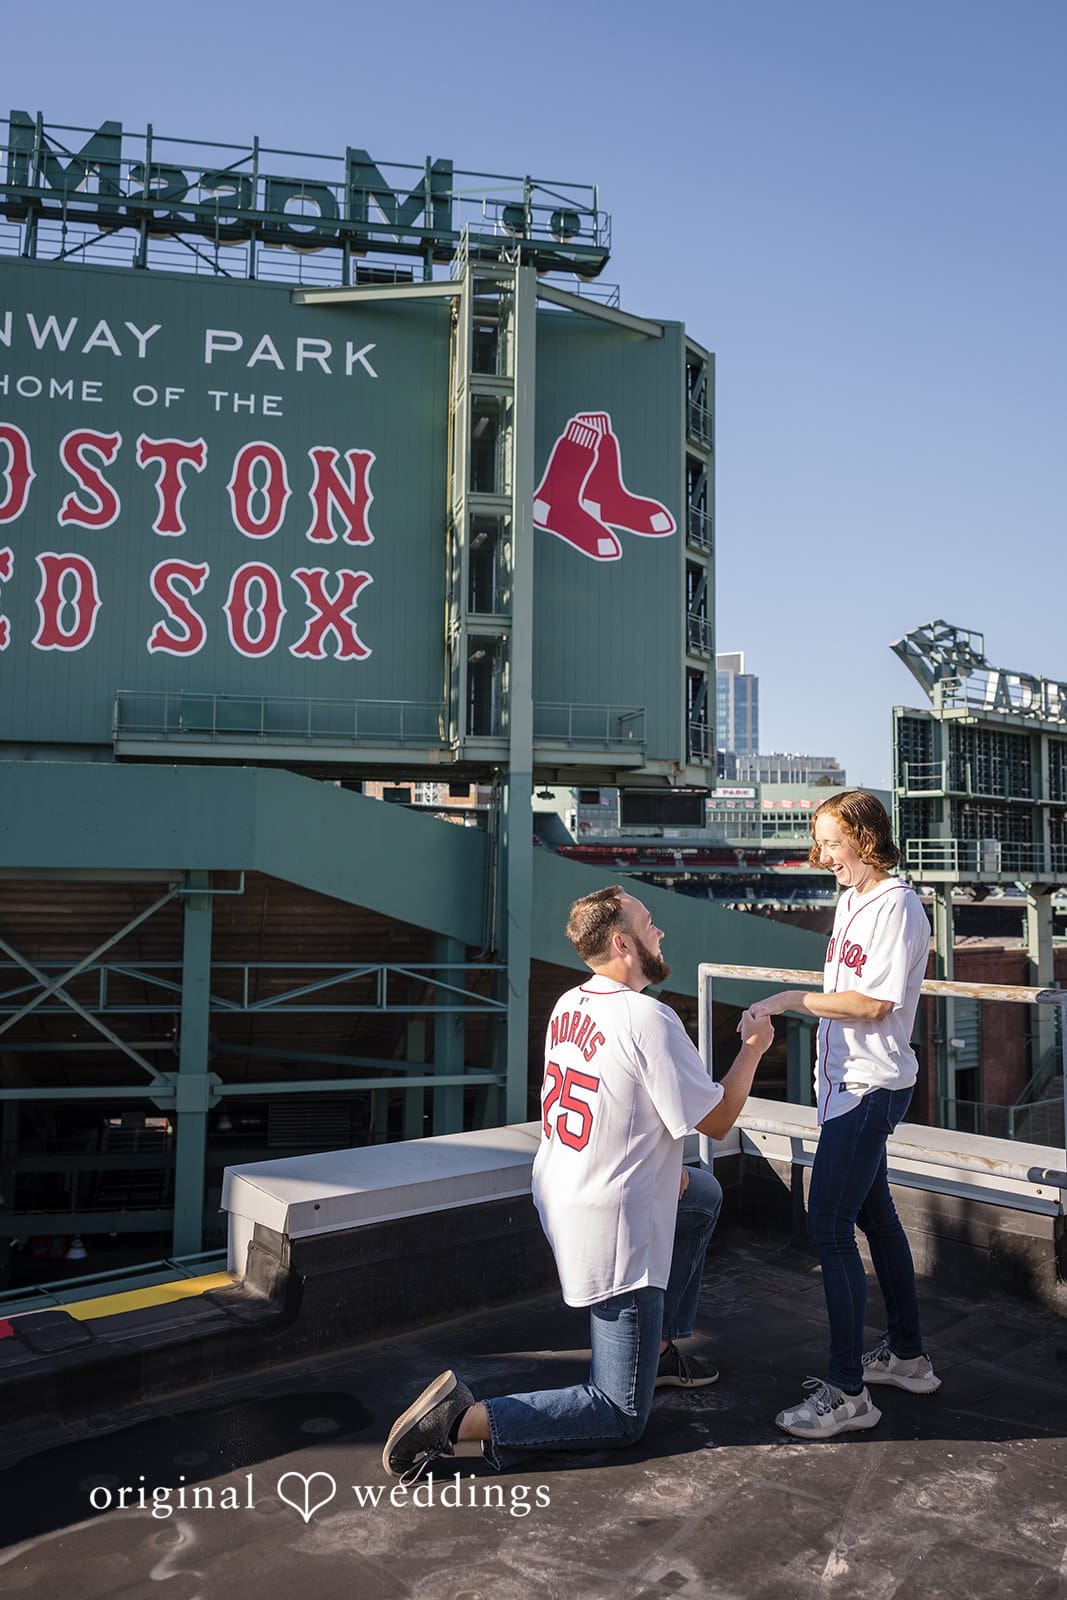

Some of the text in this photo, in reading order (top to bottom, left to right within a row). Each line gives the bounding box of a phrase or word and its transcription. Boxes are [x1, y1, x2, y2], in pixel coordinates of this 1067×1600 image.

[204, 328, 379, 378] PARK
[132, 384, 185, 407] OF
[208, 390, 283, 416] THE
[147, 558, 374, 661] SOX
[551, 1011, 606, 1062] MORRIS
[543, 1061, 600, 1152] 25
